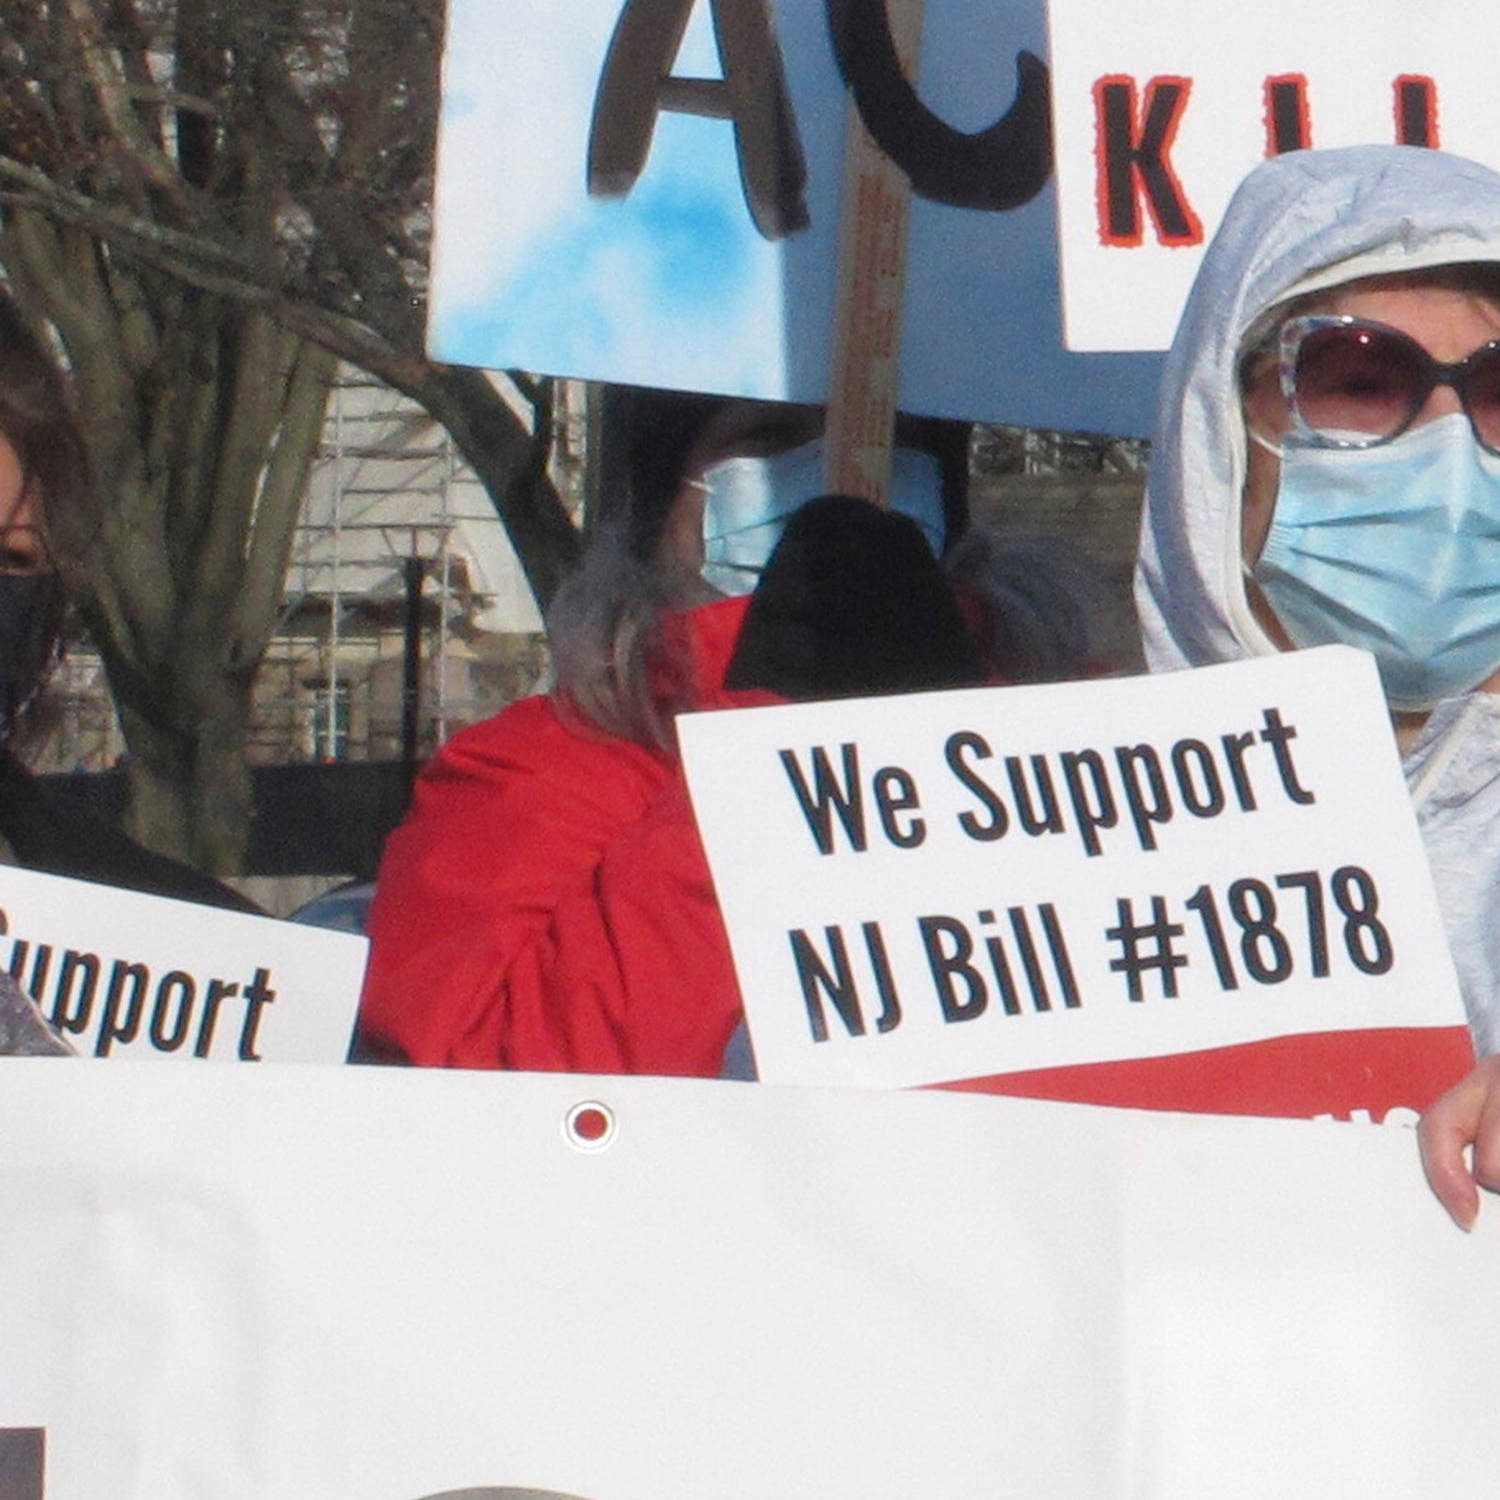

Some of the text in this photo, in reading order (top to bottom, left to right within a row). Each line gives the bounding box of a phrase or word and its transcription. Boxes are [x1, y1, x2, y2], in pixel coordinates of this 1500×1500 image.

[779, 707, 1317, 857] We Support
[788, 864, 1395, 1043] NJ Bill #1878
